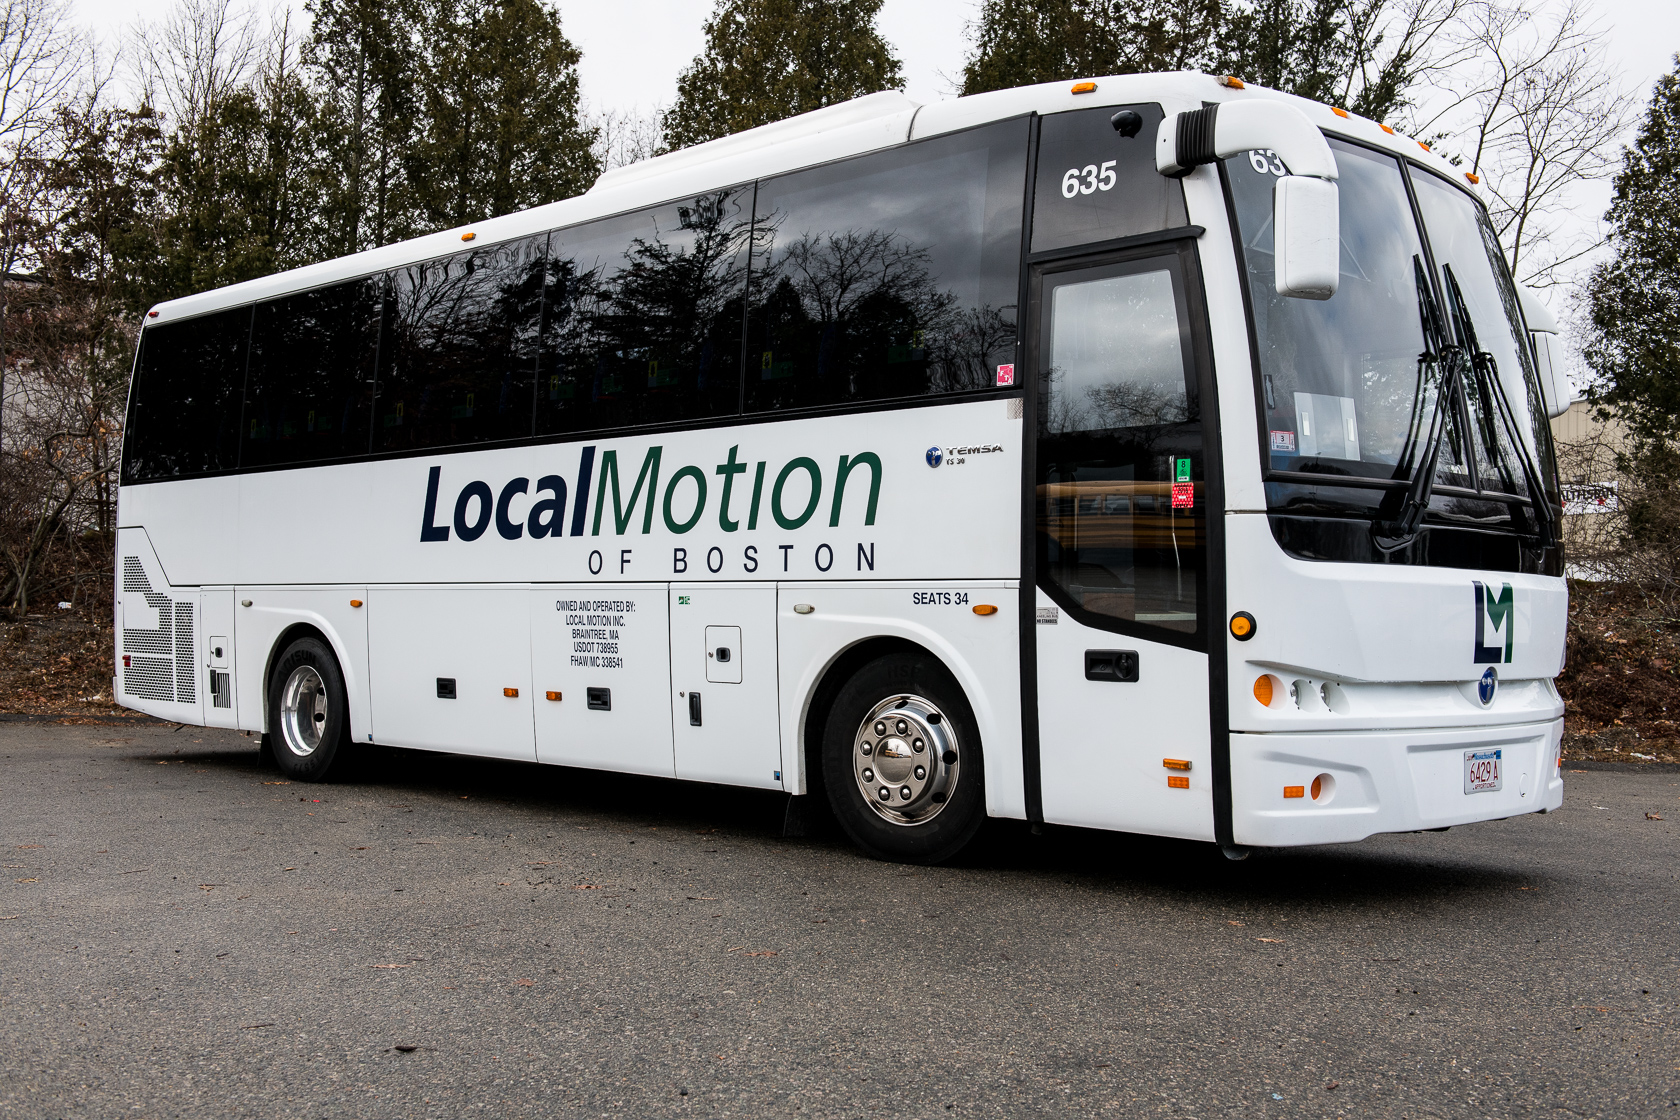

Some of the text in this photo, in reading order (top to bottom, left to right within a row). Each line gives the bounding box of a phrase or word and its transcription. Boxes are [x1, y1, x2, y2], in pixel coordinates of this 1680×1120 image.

[1248, 149, 1286, 177] 63
[1061, 160, 1117, 199] 635
[1280, 435, 1285, 443] 3
[946, 443, 1004, 456] TEMSA
[1181, 460, 1186, 468] 8
[419, 443, 883, 542] LocalMotion
[588, 543, 875, 575] OF BOSTON
[912, 592, 969, 605] SEATS 34
[556, 600, 636, 612] OWNED AND OPERATED BY:
[565, 614, 626, 627] LOCAL MOTION INC.
[1471, 580, 1514, 664] LM
[572, 629, 620, 641] BRAINTREE, MA
[573, 641, 619, 654] USDOT 738955
[601, 656, 623, 668] 338541
[1470, 760, 1499, 784] 6429 A
